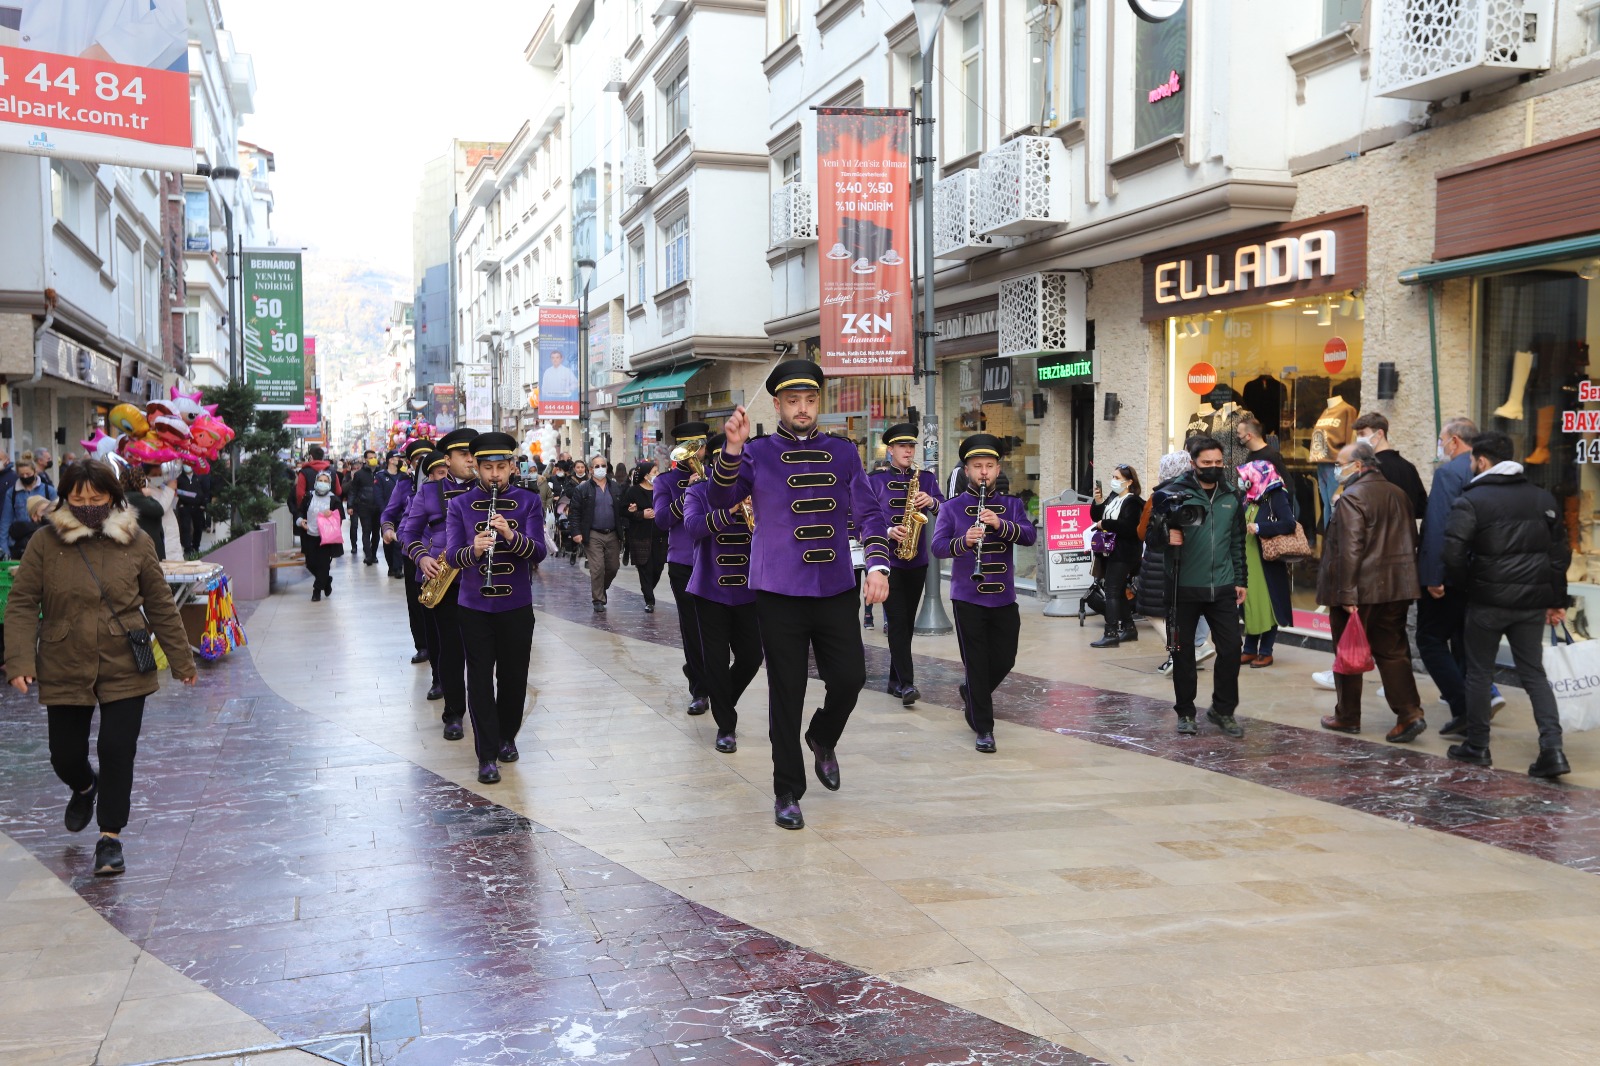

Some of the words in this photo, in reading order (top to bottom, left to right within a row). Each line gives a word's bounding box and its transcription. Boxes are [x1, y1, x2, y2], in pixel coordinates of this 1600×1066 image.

[24, 62, 80, 96] 44
[95, 71, 147, 105] 84
[823, 159, 839, 168] Yeni
[882, 159, 907, 169] Olmaz
[835, 181, 862, 194] %40
[867, 182, 893, 194] %50
[835, 201, 856, 212] %10
[857, 200, 894, 212] İNDİRİM
[250, 259, 296, 270] BERNARDO
[1155, 230, 1336, 304] ELLADA
[255, 271, 276, 281] YENİ
[278, 273, 293, 281] YIL
[255, 281, 294, 291] İNDİRİMİ
[841, 313, 892, 334] ZEN
[964, 316, 999, 336] AYAKK
[848, 334, 886, 343] diamond
[1323, 349, 1346, 363] İNDİRİM
[1038, 359, 1091, 380] TERZİ&BUTİK
[984, 366, 1010, 391] MLD
[1188, 375, 1216, 384] İNDİRİM
[1579, 381, 1600, 402] Se
[1562, 411, 1600, 432] BAY
[1057, 508, 1080, 517] TERZİ
